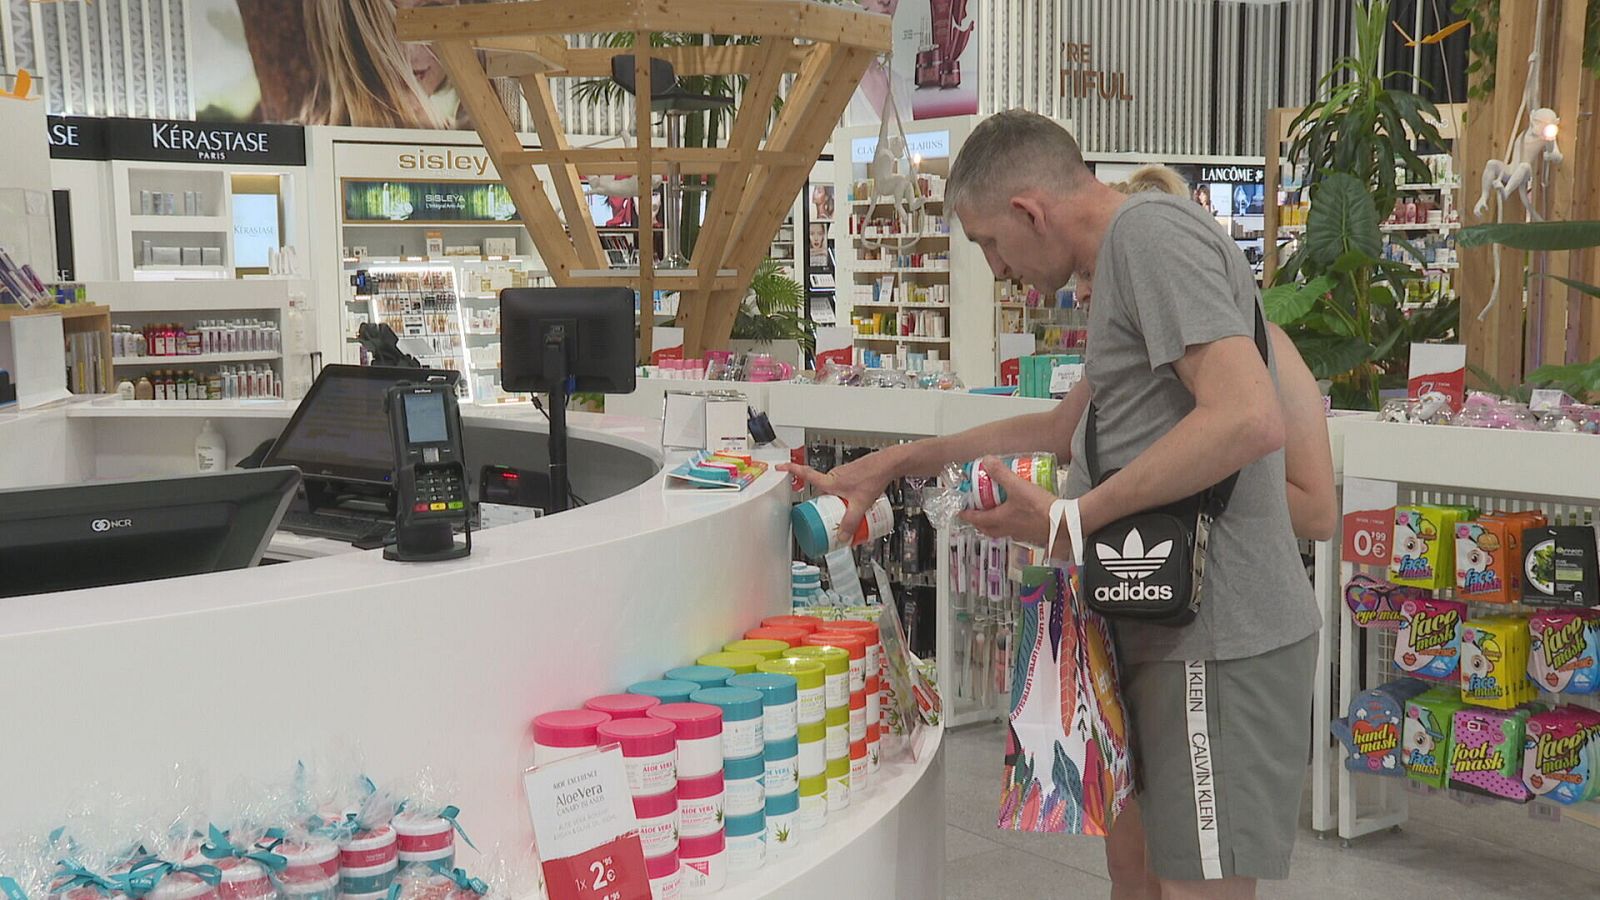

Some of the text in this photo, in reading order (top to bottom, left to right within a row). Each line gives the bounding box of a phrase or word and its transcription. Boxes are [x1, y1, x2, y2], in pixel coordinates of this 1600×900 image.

[152, 122, 269, 152] KÉRASTASE
[198, 151, 226, 160] PARIS
[398, 149, 489, 175] sisley
[1202, 165, 1254, 181] LANCÔME
[111, 519, 132, 528] NCR
[1400, 555, 1428, 571] face
[1465, 568, 1496, 586] face
[1094, 582, 1173, 601] adidas
[1409, 610, 1458, 647] face
[1415, 624, 1456, 652] mask
[1542, 617, 1583, 667] face
[1552, 632, 1587, 670] mask
[1188, 672, 1204, 712] KLEIN
[1469, 673, 1497, 691] face
[1353, 724, 1390, 745] hand
[1359, 733, 1398, 753] mask
[1451, 741, 1489, 765] foot
[1535, 723, 1587, 769] face
[1408, 749, 1435, 766] face
[1455, 751, 1504, 772] mask
[1542, 749, 1580, 775] mask
[1191, 732, 1215, 831] CALVIN KLEIN
